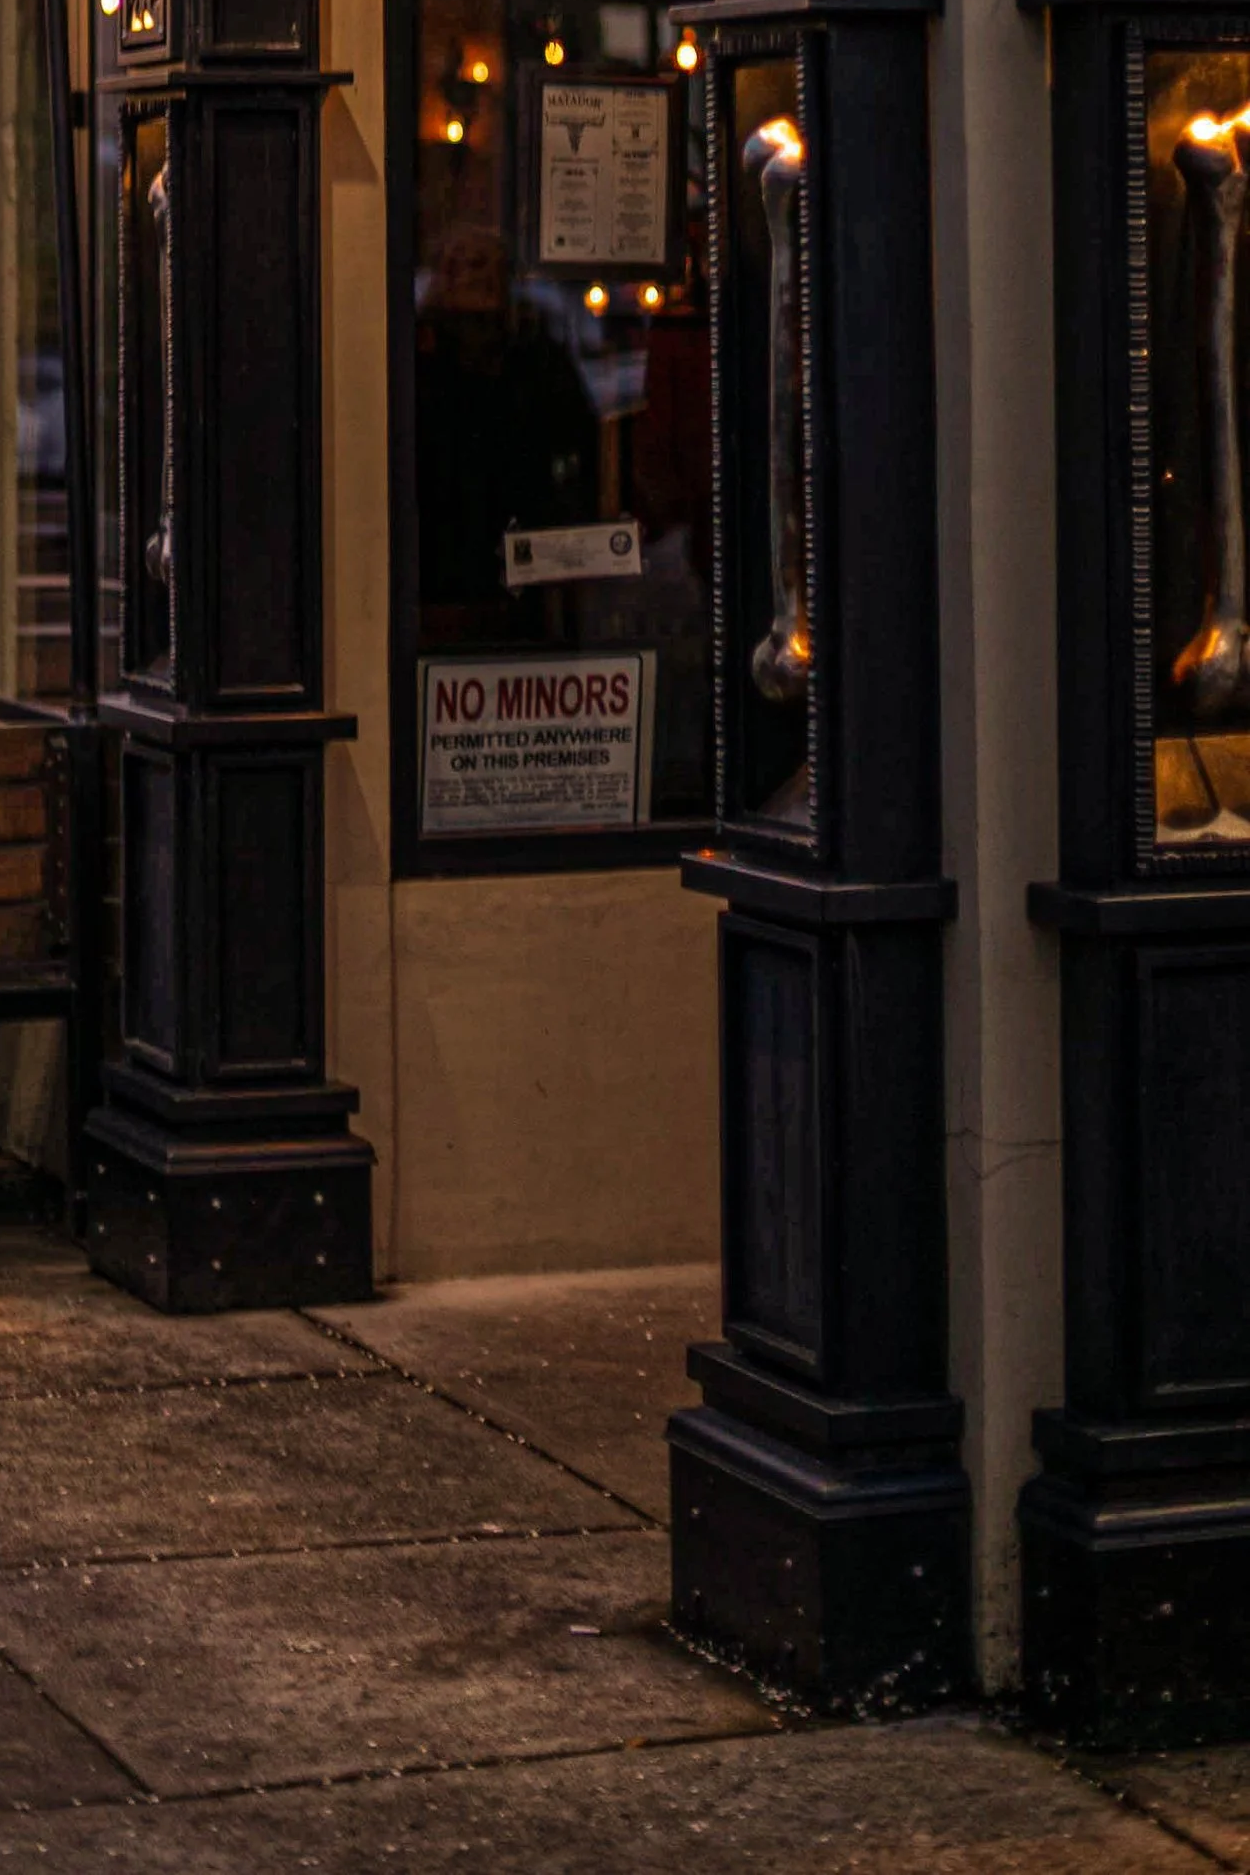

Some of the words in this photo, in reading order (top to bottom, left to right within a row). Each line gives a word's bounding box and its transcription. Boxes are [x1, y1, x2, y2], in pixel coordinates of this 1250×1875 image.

[436, 677, 485, 723] NO
[497, 672, 630, 721] MINORS
[431, 730, 529, 751] PERMITTED
[533, 727, 632, 746] ANYWHERE
[451, 755, 477, 771] ON
[482, 752, 519, 770] THIS
[523, 749, 611, 768] PREMISES
